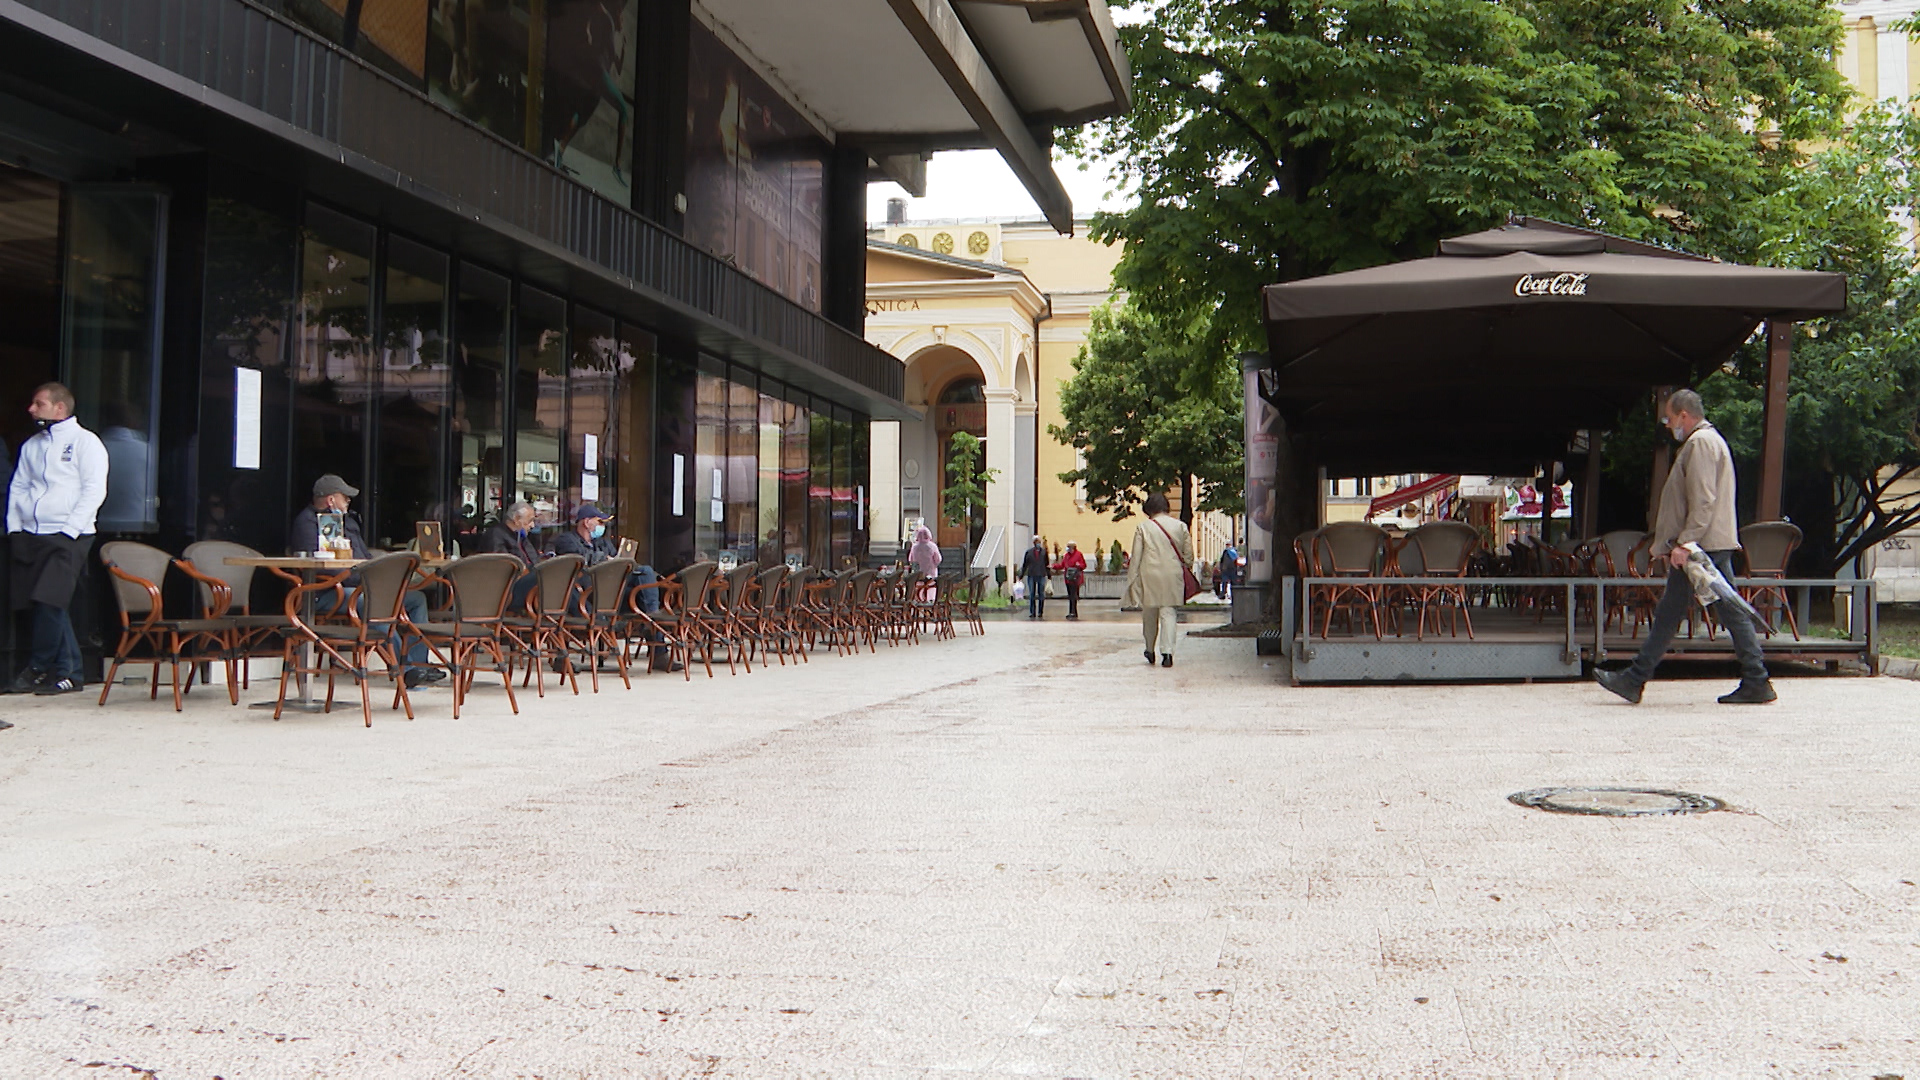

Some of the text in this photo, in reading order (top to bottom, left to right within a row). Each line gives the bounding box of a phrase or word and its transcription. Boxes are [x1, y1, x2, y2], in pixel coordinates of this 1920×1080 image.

[744, 168, 783, 207] SPORTS
[744, 189, 782, 229] FOR ALL
[1514, 272, 1590, 297] Coca-Cola
